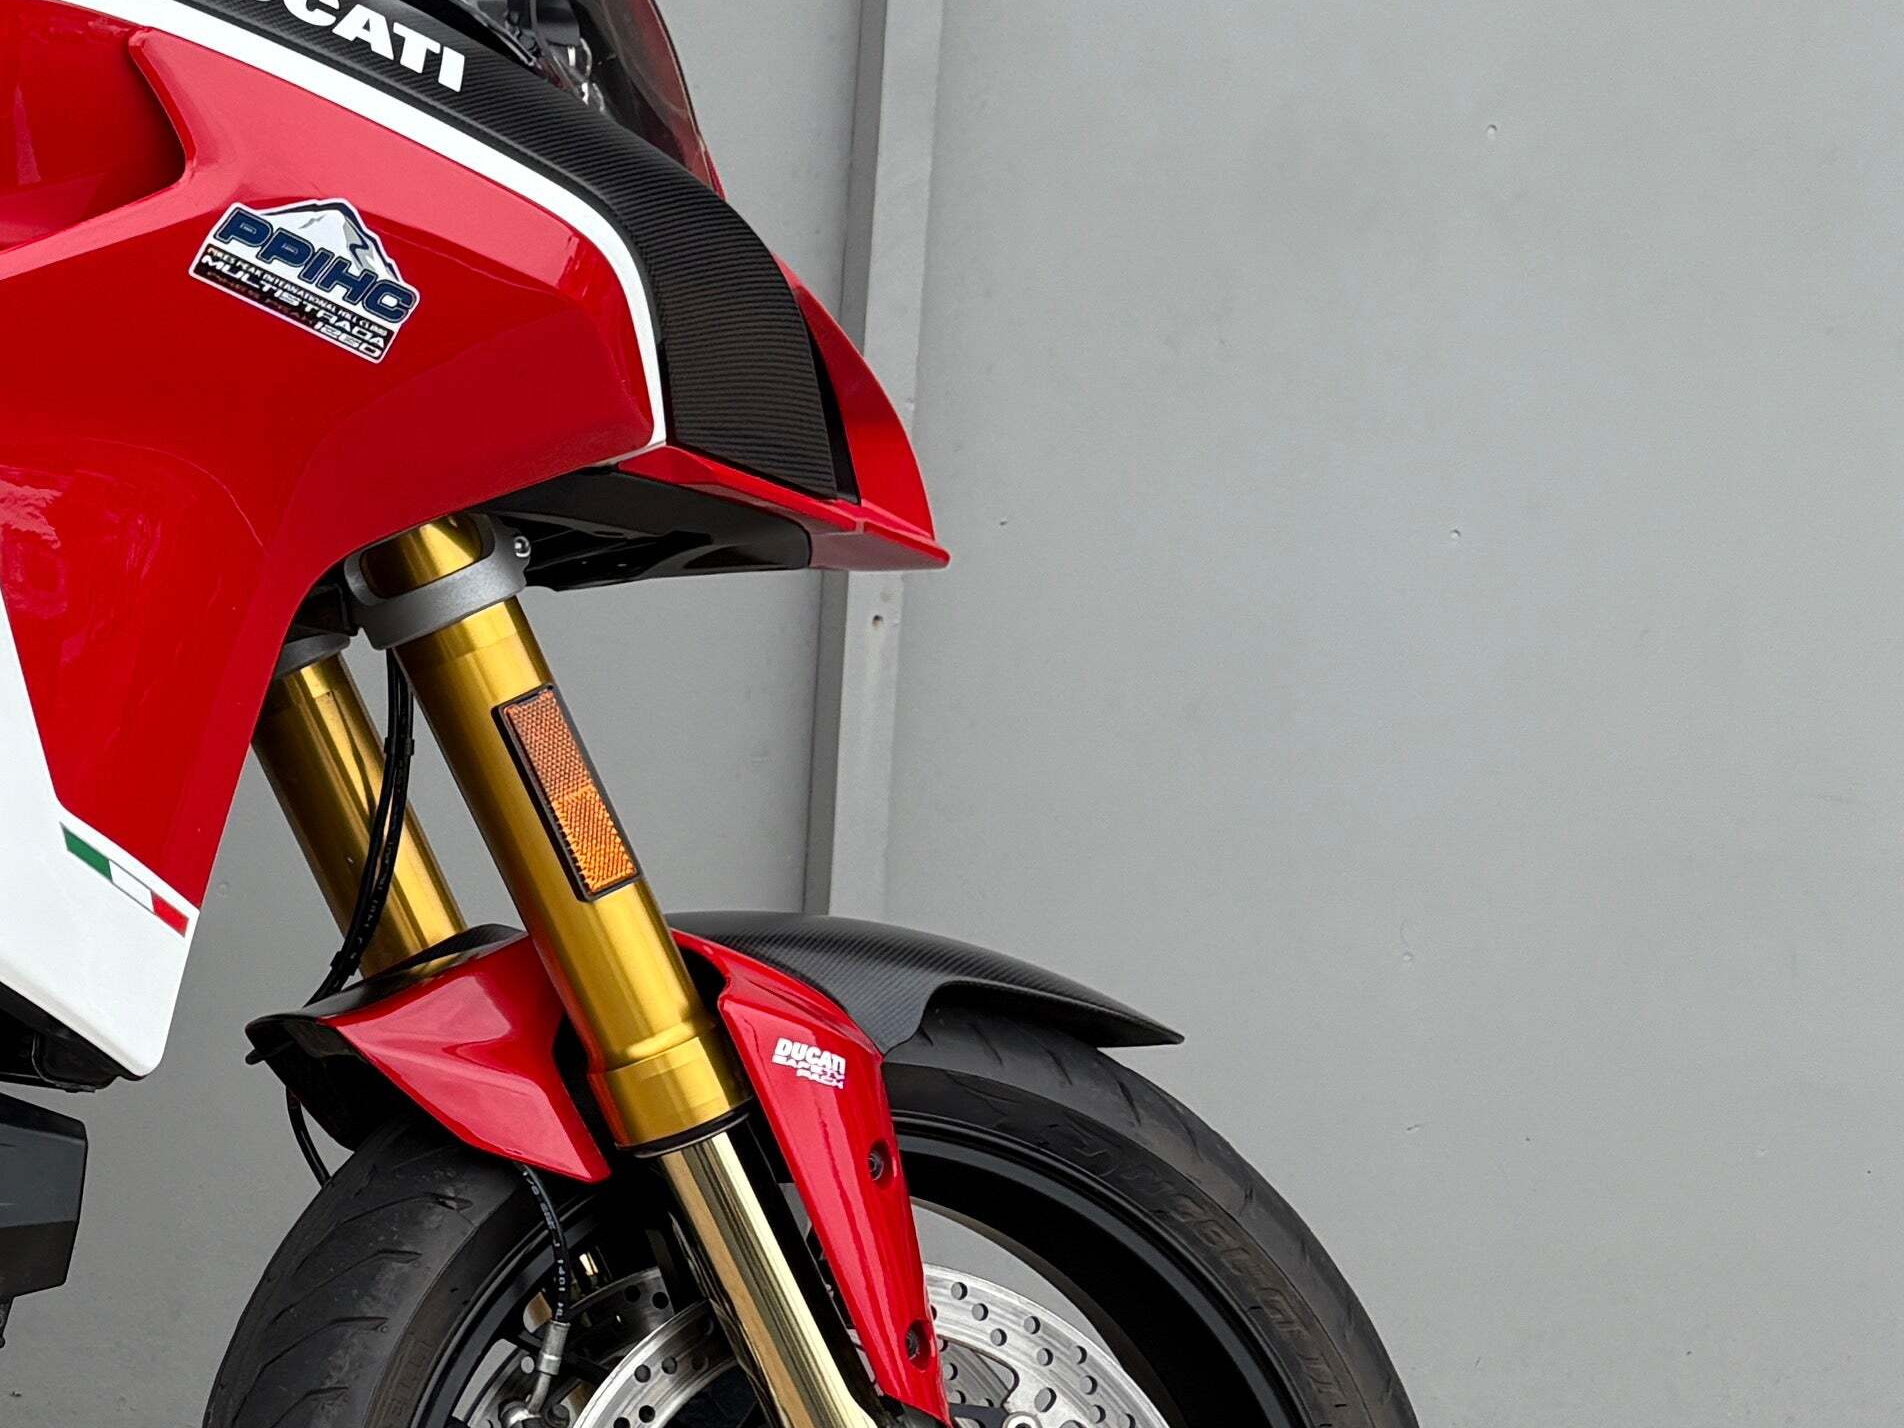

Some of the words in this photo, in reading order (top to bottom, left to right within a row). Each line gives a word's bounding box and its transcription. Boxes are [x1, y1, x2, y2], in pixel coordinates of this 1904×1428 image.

[213, 207, 417, 322] PPIHC
[234, 259, 262, 277] PEAK
[260, 272, 337, 313] INTERNATIONAL
[198, 253, 389, 349] MULTISTRADA
[312, 319, 383, 360] 1260
[774, 1037, 846, 1076] DUCATI
